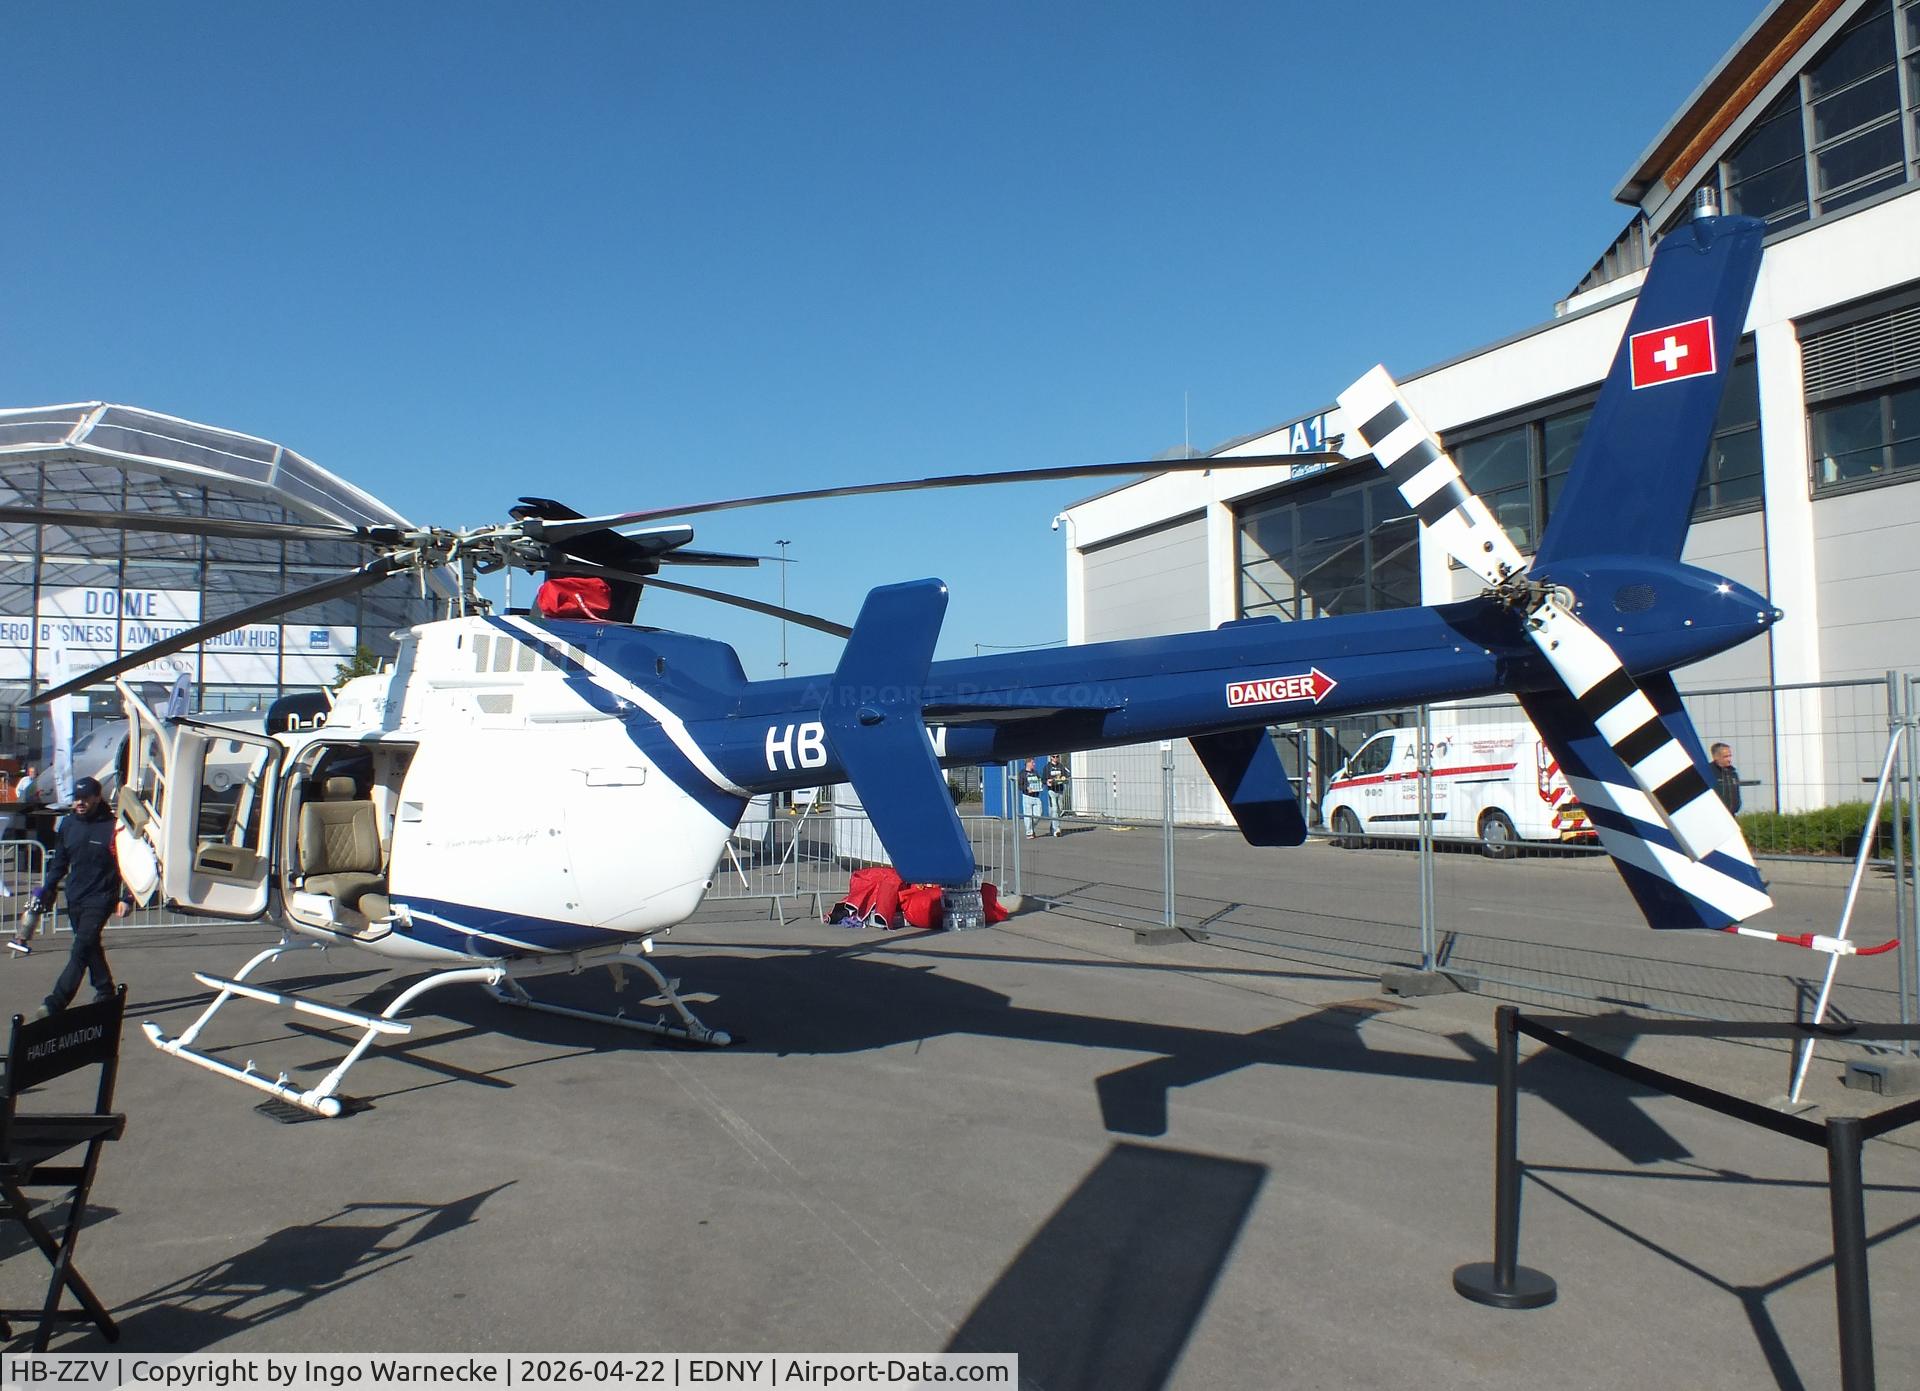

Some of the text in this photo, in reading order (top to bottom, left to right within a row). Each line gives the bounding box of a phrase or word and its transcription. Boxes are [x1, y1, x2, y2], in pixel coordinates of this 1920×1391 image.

[1290, 415, 1322, 453] A1
[85, 591, 157, 615] DOME
[42, 626, 113, 643] BSINESS
[250, 631, 277, 647] HUB
[1230, 677, 1316, 704] DANGER
[28, 1024, 103, 1060] HAUTE AVIATION
